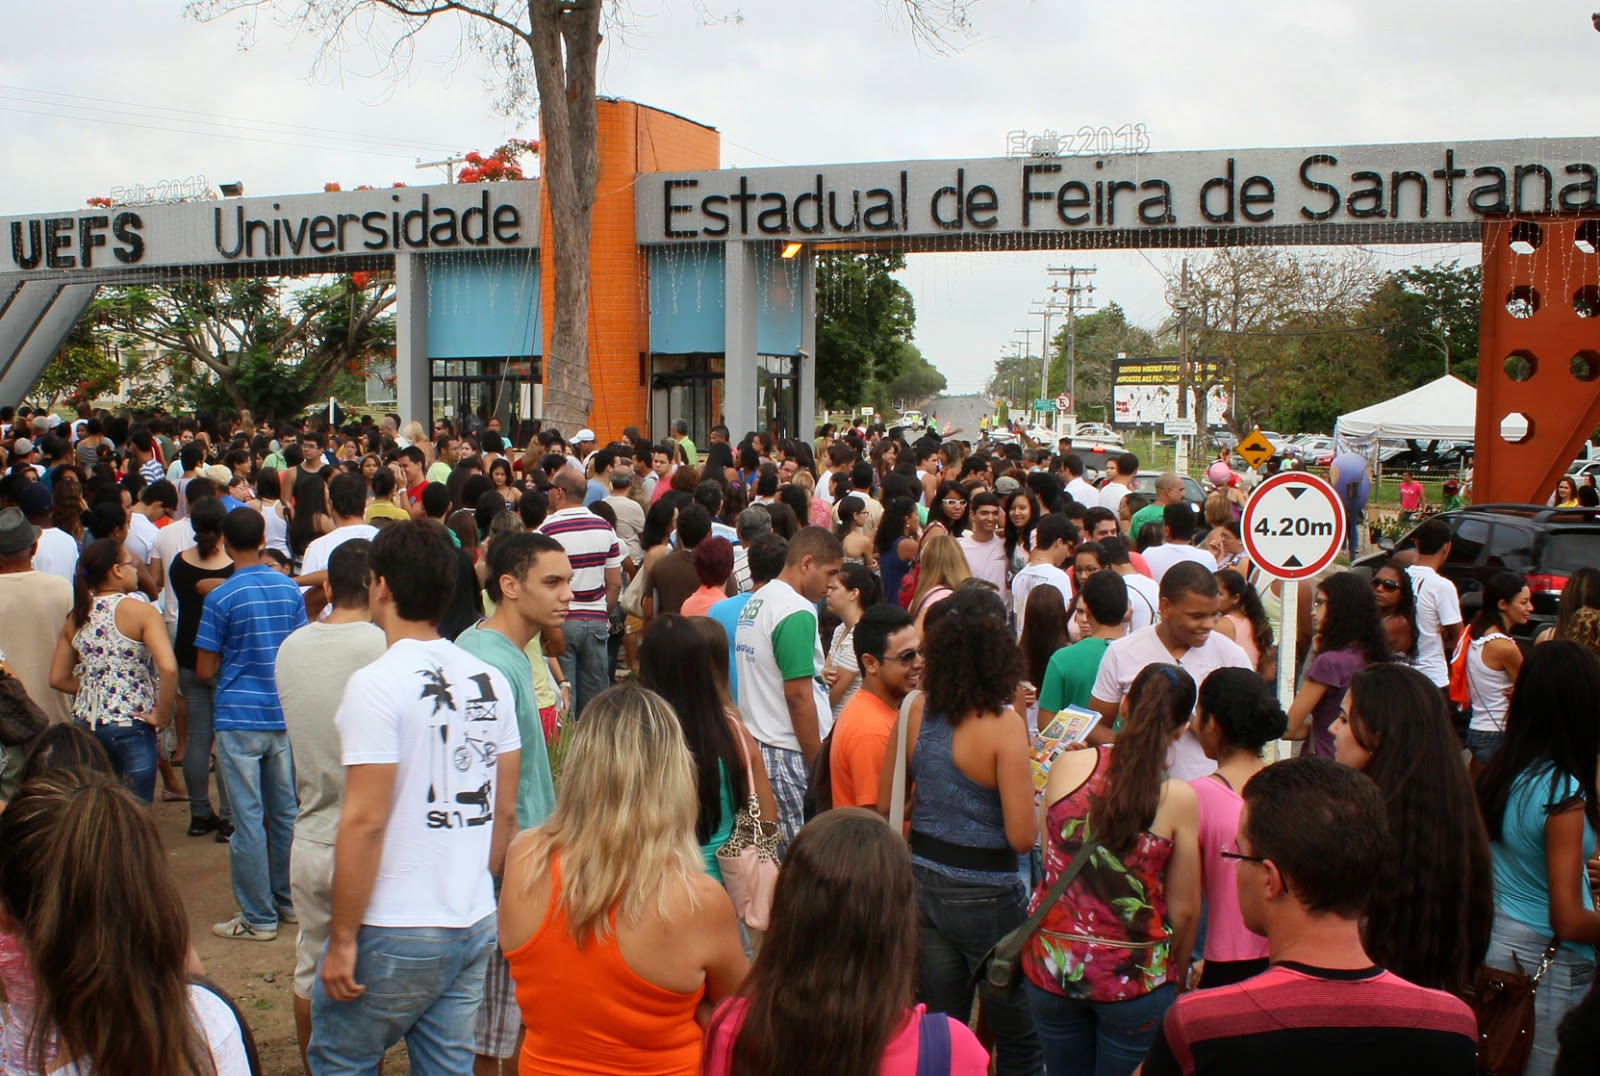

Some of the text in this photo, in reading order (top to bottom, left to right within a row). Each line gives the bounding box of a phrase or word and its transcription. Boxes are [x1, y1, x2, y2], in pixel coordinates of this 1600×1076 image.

[215, 190, 520, 260] Universidade
[664, 149, 1600, 239] Estadual de Feira de Santana
[11, 212, 144, 270] UEFS
[1254, 517, 1332, 536] 4.20m
